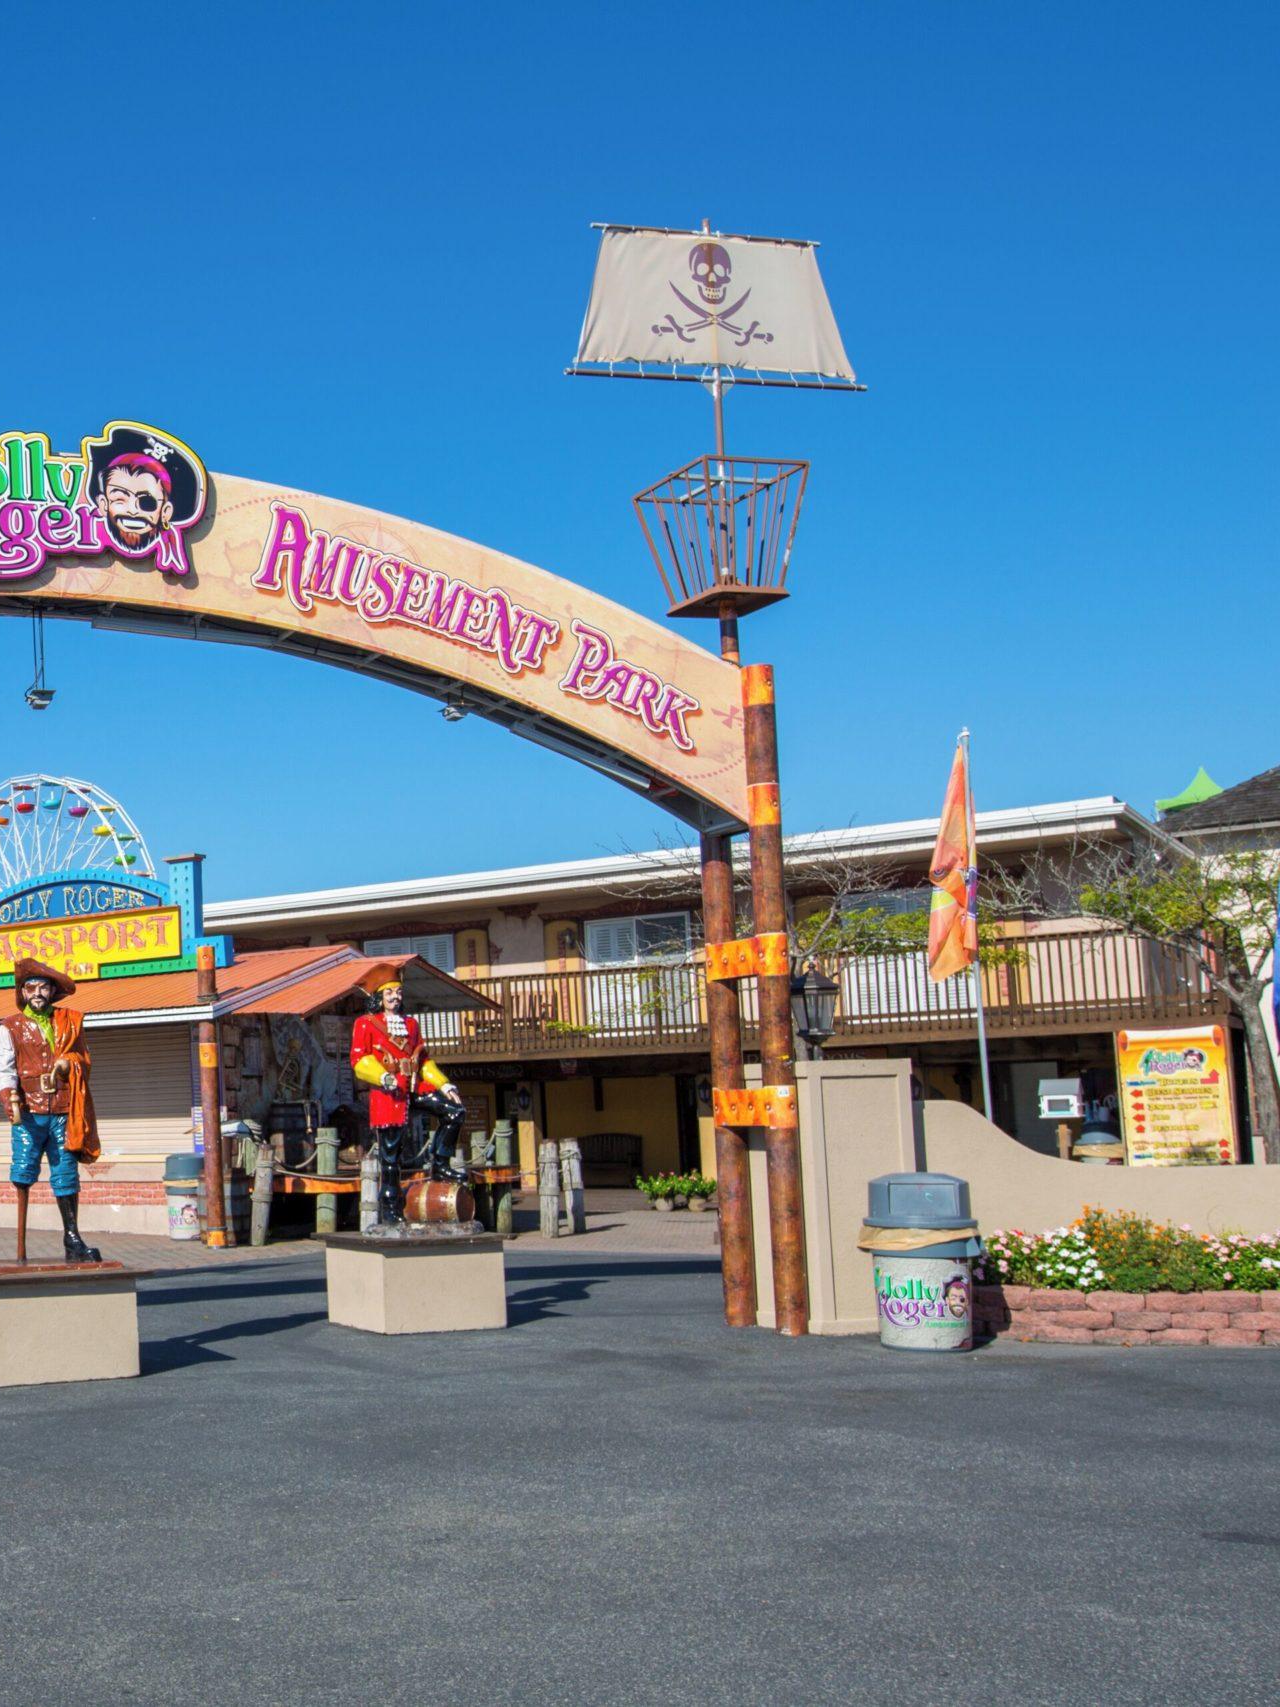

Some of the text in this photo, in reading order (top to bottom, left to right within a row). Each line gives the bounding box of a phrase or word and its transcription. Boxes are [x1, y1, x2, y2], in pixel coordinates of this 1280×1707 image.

[252, 500, 700, 750] AMUSEMENT PARK
[63, 885, 145, 916] ROGER
[881, 1274, 940, 1303] Jolly
[878, 1293, 947, 1329] Roger
